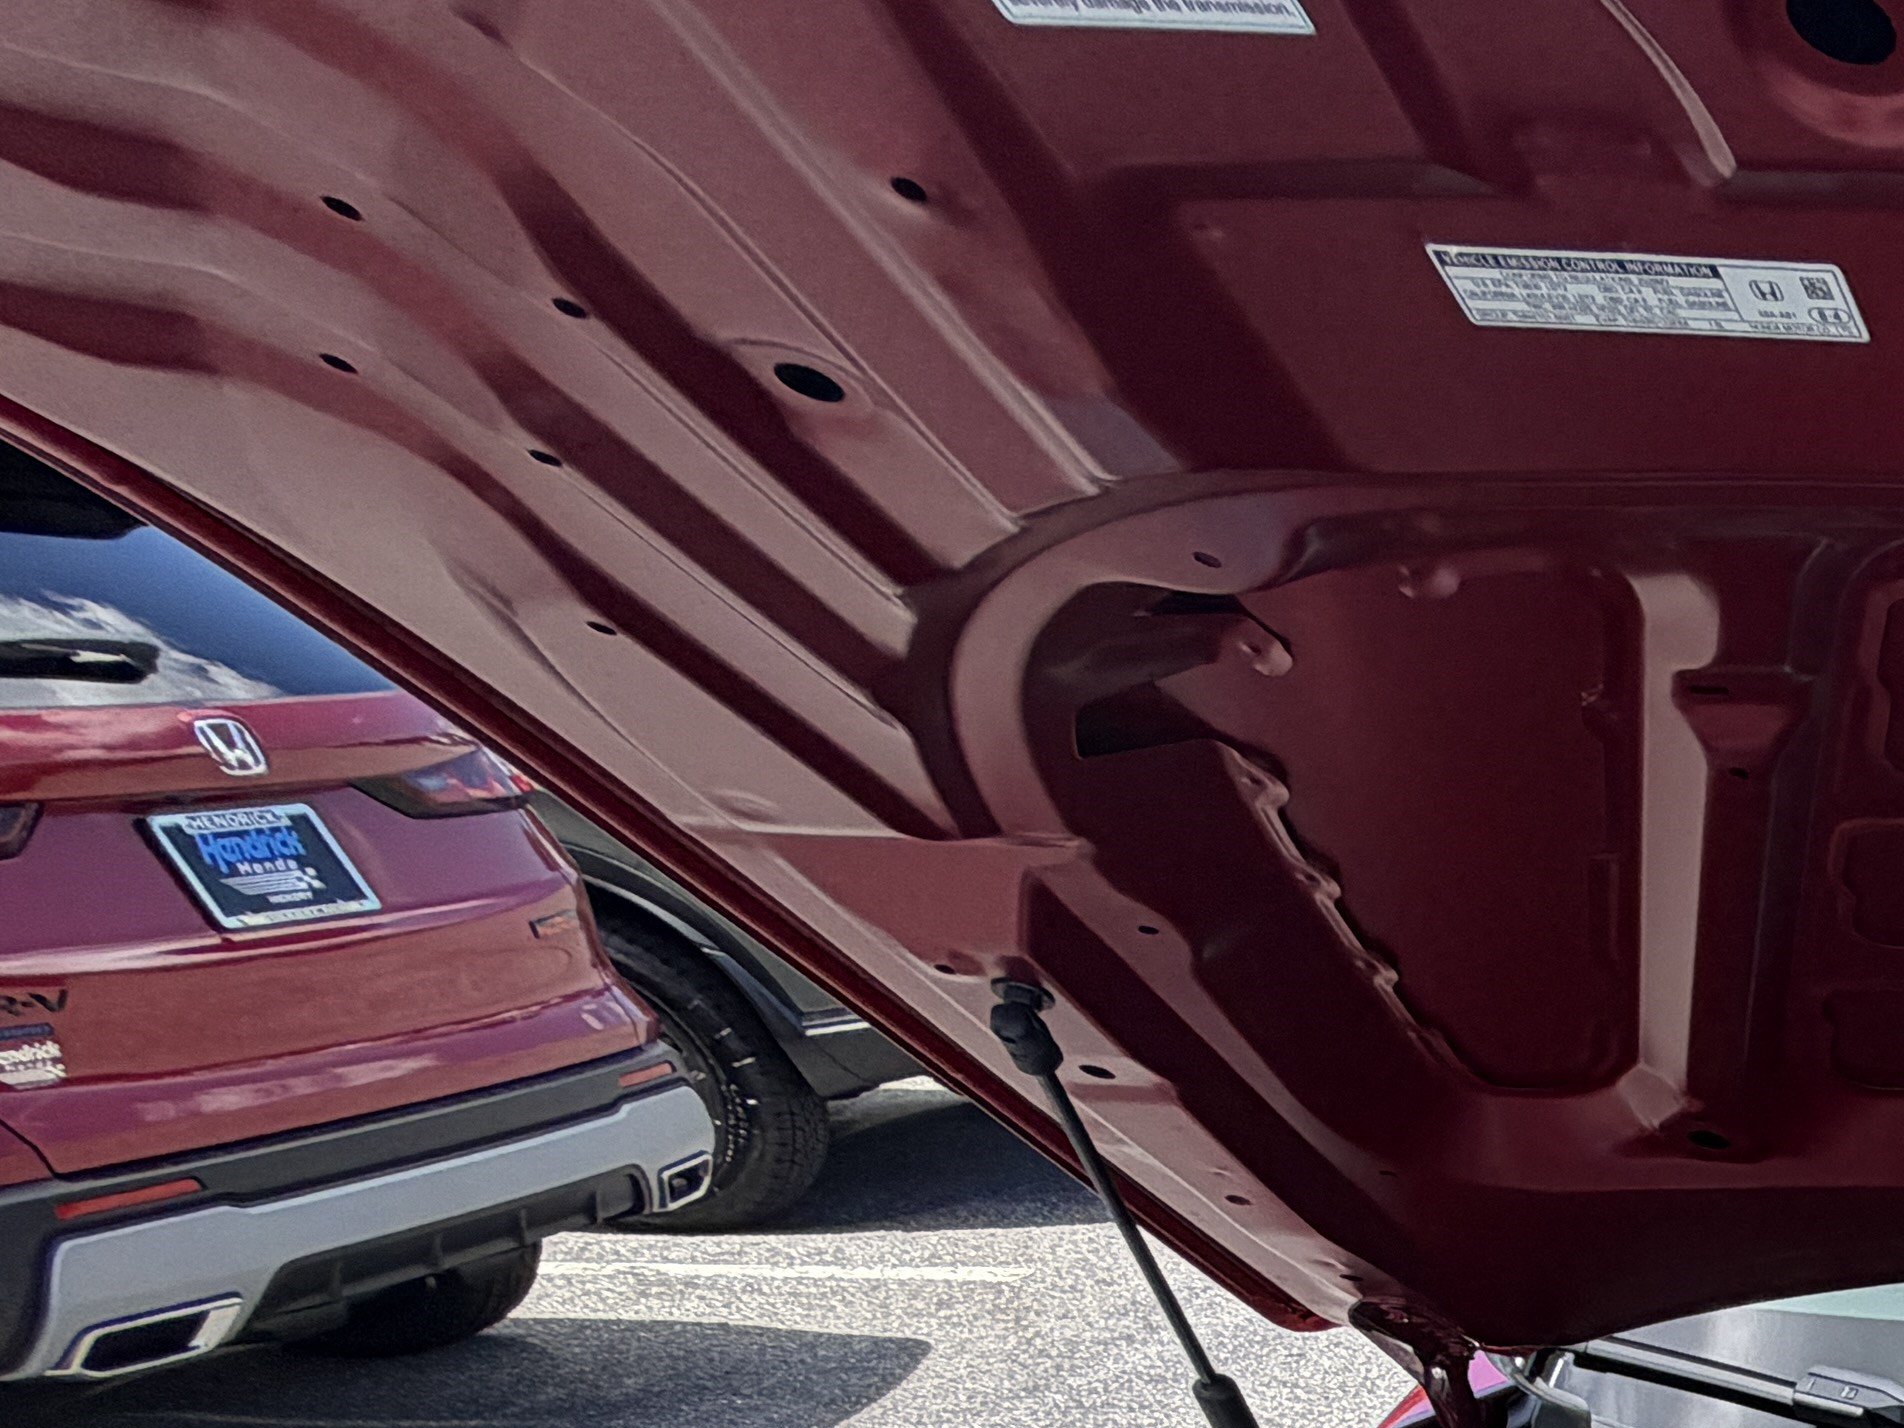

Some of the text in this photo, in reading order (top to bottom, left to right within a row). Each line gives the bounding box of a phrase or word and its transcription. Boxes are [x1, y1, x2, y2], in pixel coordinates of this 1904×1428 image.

[1442, 251, 1714, 277] VEHICLE EMISSION CONTROL INFORMATION
[195, 826, 307, 875] Hendrick
[235, 859, 298, 875] Honda
